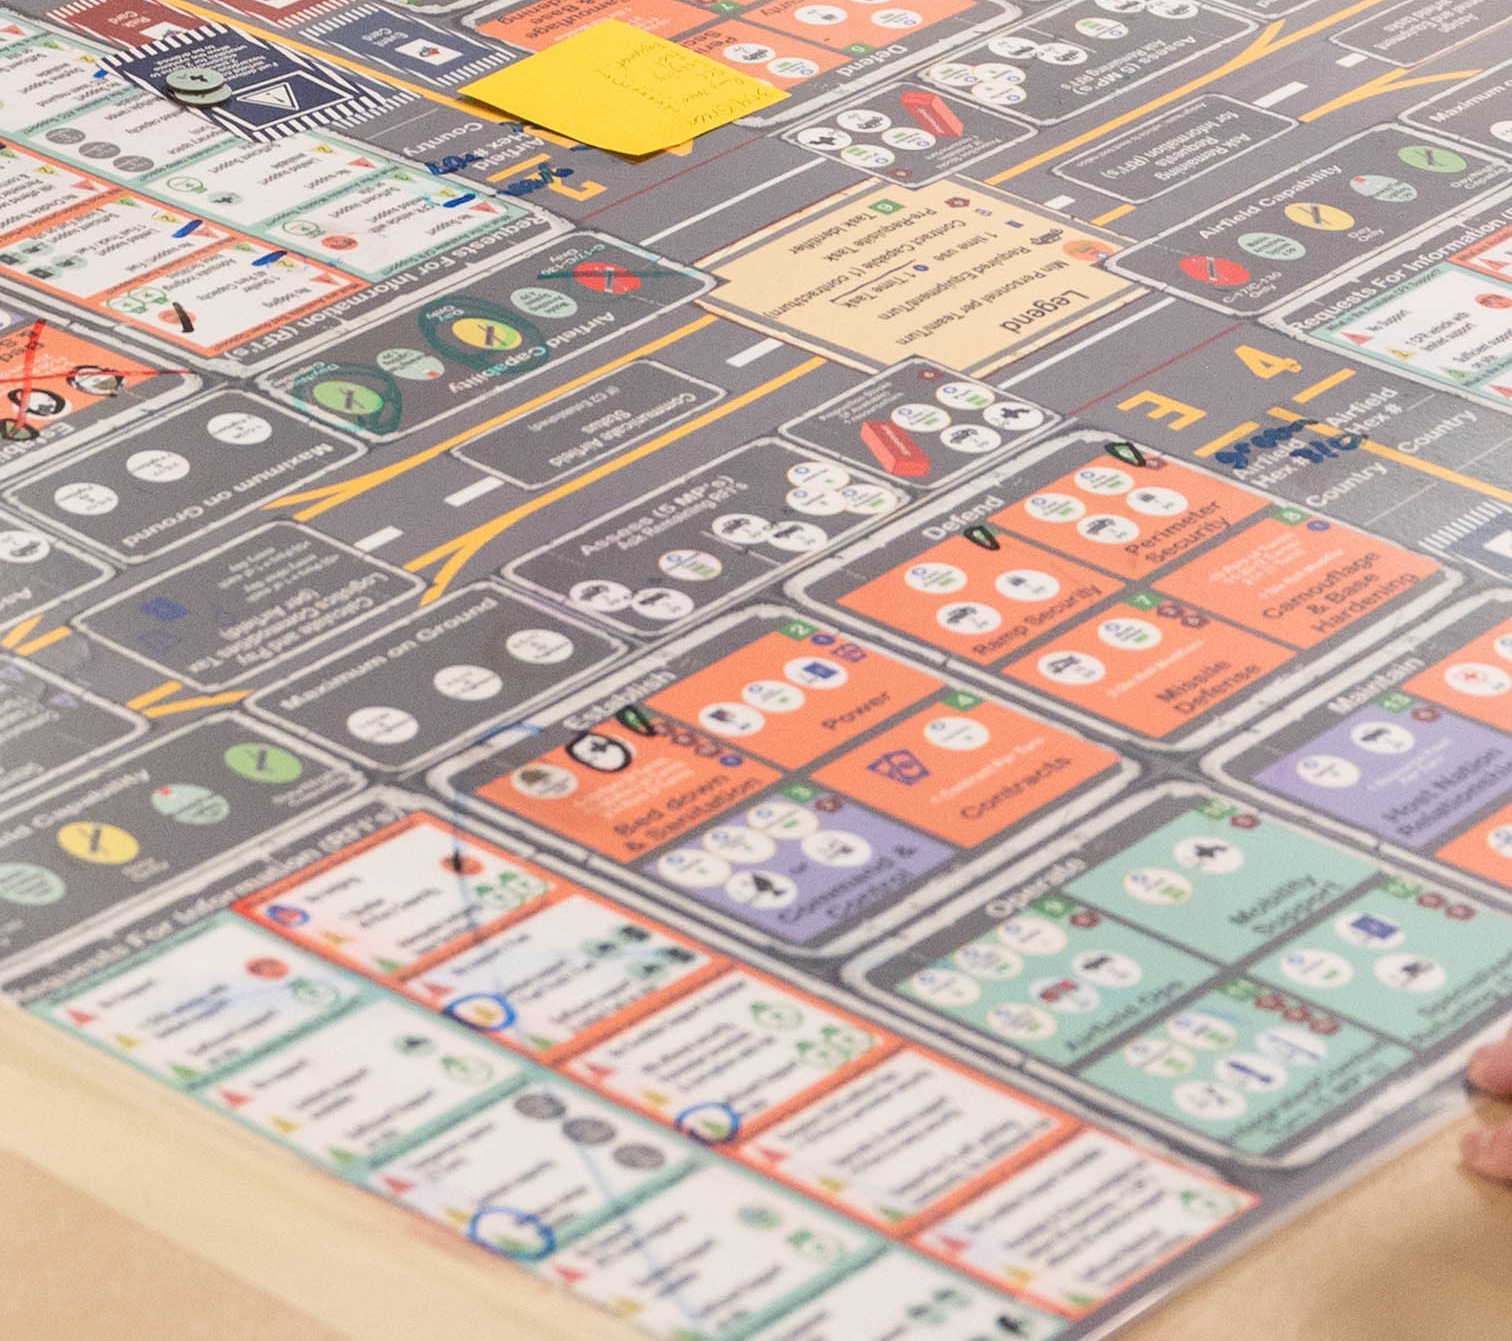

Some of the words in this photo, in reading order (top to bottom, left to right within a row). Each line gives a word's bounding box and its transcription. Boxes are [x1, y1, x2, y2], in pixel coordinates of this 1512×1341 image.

[108, 5, 146, 25] Card
[124, 14, 153, 31] Risk
[835, 41, 910, 76] Defend
[1139, 34, 1197, 67] Assess
[402, 120, 484, 157] Country
[472, 135, 546, 171] Airfield
[1154, 143, 1224, 182] Remaining
[844, 211, 876, 228] Task
[1198, 198, 1263, 241] Airfield
[1260, 163, 1342, 208] Capability
[451, 212, 546, 263] Requests
[789, 227, 847, 256] Identifier
[853, 207, 937, 252] Pre-Requisite
[914, 219, 966, 247] Contract
[415, 255, 449, 279] For
[823, 244, 854, 263] Task
[862, 241, 916, 273] Capable
[933, 248, 956, 262] use
[974, 245, 1031, 276] Required
[1042, 260, 1069, 277] Min
[875, 276, 907, 295] Time
[877, 268, 976, 322] Equipment/Turn
[981, 268, 1040, 302] Personnel
[1286, 286, 1374, 334] Requests
[1375, 270, 1407, 293] For
[1405, 218, 1508, 275] Information
[295, 269, 417, 328] Information
[761, 274, 849, 319] contract/turn)
[842, 291, 875, 309] Task
[962, 298, 982, 314] per
[999, 289, 1089, 334] Legend
[222, 323, 297, 361] (RFI's)
[547, 309, 617, 350] Airfield
[895, 309, 962, 346] Team/Turn
[447, 345, 547, 394] Capability
[580, 407, 633, 435] Status
[605, 391, 697, 448] Communicate
[1325, 389, 1398, 429] Airfield
[1344, 415, 1384, 438] Hex
[548, 436, 606, 468] Airfield
[1397, 410, 1479, 457] Country
[231, 443, 326, 496] Maximum
[1305, 461, 1388, 508] Country
[121, 513, 200, 548] Ground
[921, 496, 1006, 542] Defend
[1124, 500, 1221, 557] Perimeter
[1142, 518, 1235, 566] Security
[972, 619, 1032, 656] Ramp
[1024, 583, 1104, 630] Security
[1155, 658, 1232, 704] Missile
[1171, 663, 1263, 713] Defense
[1326, 656, 1427, 714] Maintain
[820, 690, 892, 732] Power
